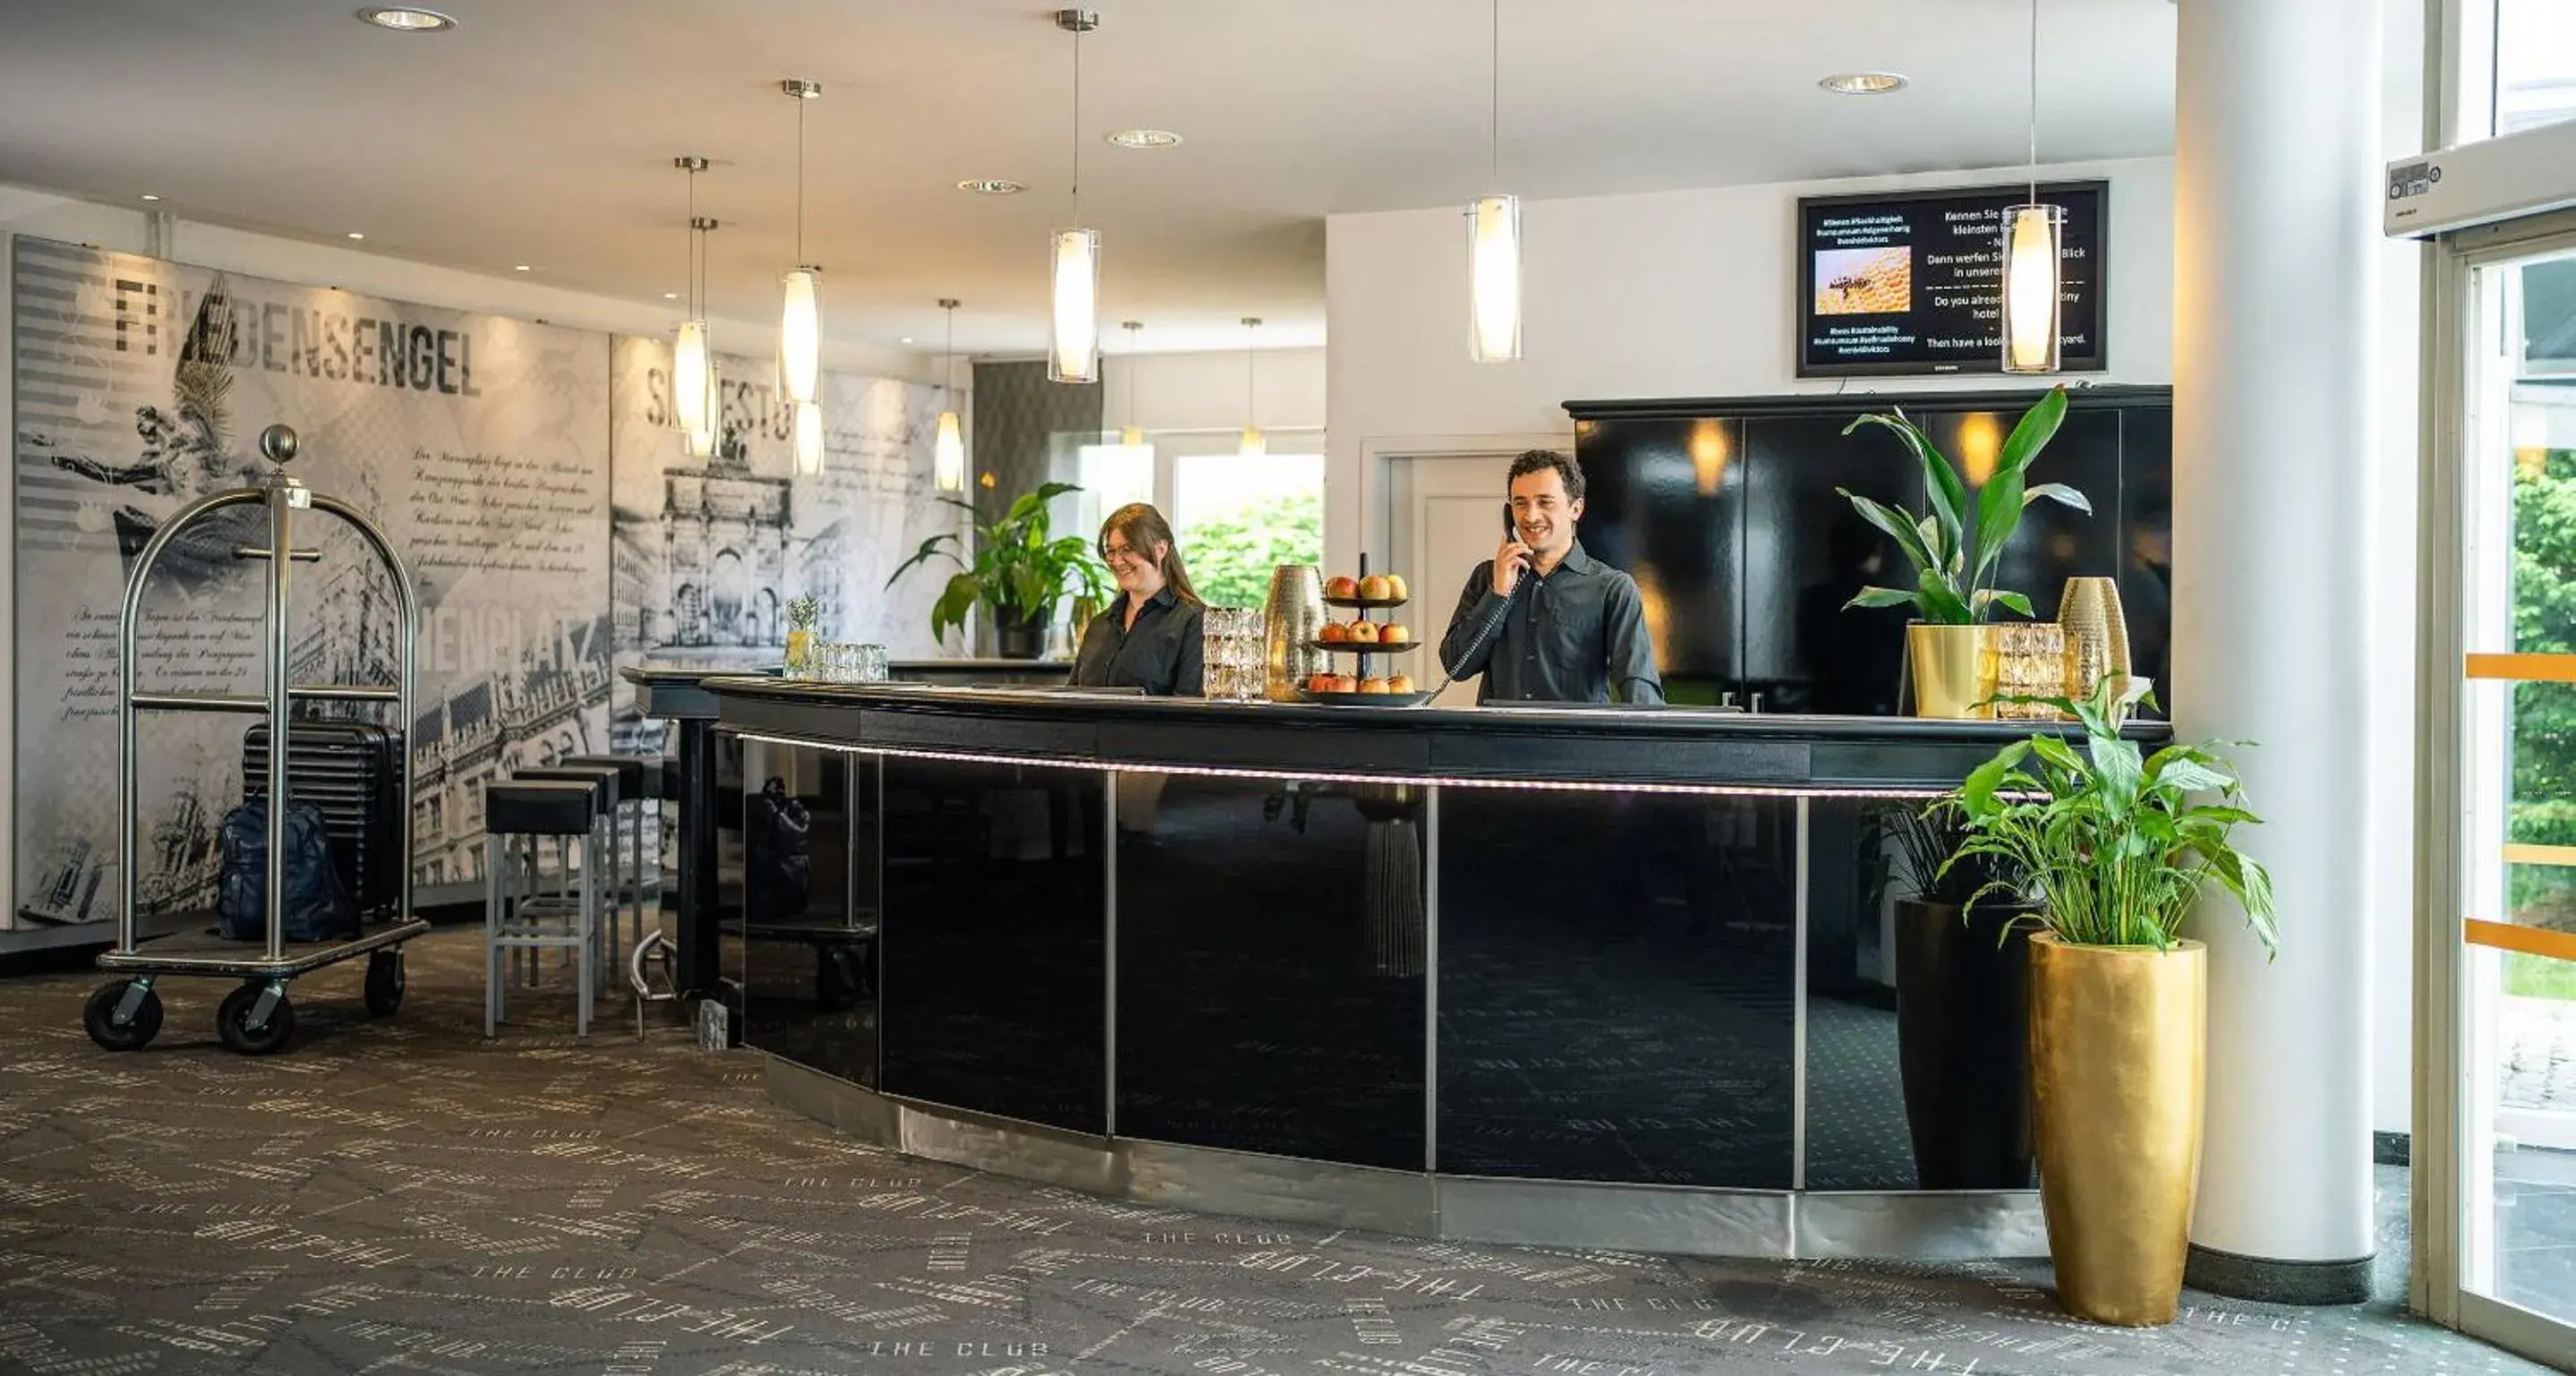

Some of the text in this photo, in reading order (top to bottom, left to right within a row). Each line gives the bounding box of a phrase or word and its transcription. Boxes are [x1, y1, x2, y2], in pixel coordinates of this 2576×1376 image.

[1945, 211, 1982, 221] Kennen
[1984, 209, 1999, 219] Sie
[1954, 224, 1998, 235] kleinsten
[1927, 254, 1953, 265] Dann
[1956, 252, 1990, 263] werfen
[2061, 248, 2086, 258] Blick
[1934, 296, 1949, 307] Do
[1950, 298, 1969, 308] you
[1972, 309, 2000, 319] hotel
[115, 278, 482, 397] FRIEDENSENGEL
[1926, 338, 1949, 348] Then
[1951, 338, 1975, 347] have
[473, 1266, 638, 1279] THE CLUB
[873, 1341, 1049, 1357] THE CLUB
